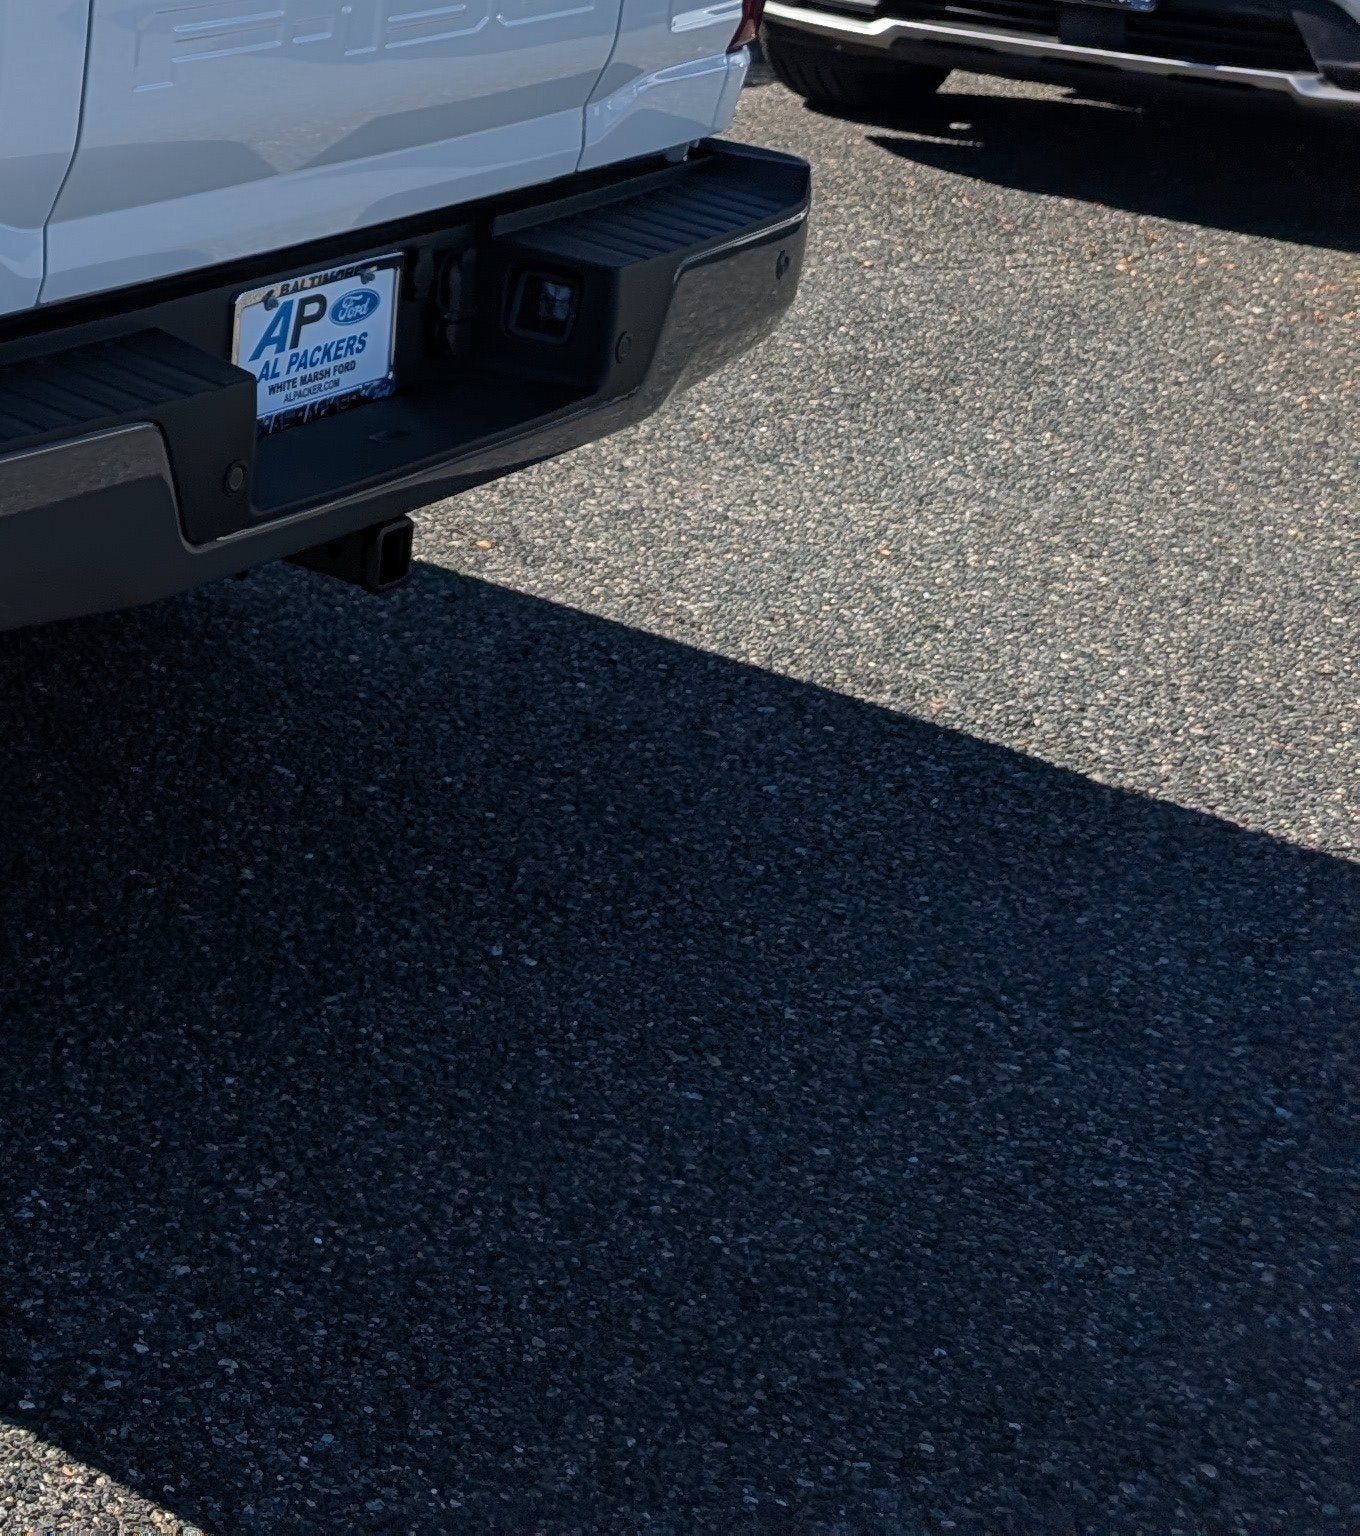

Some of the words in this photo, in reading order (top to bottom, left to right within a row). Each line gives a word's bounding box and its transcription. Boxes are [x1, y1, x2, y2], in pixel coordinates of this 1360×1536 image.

[248, 293, 327, 362] AP
[258, 358, 280, 382] AL
[285, 331, 368, 375] PACKERS
[268, 378, 298, 395] WHITE
[299, 368, 331, 387] MARSH
[333, 360, 356, 376] FORD
